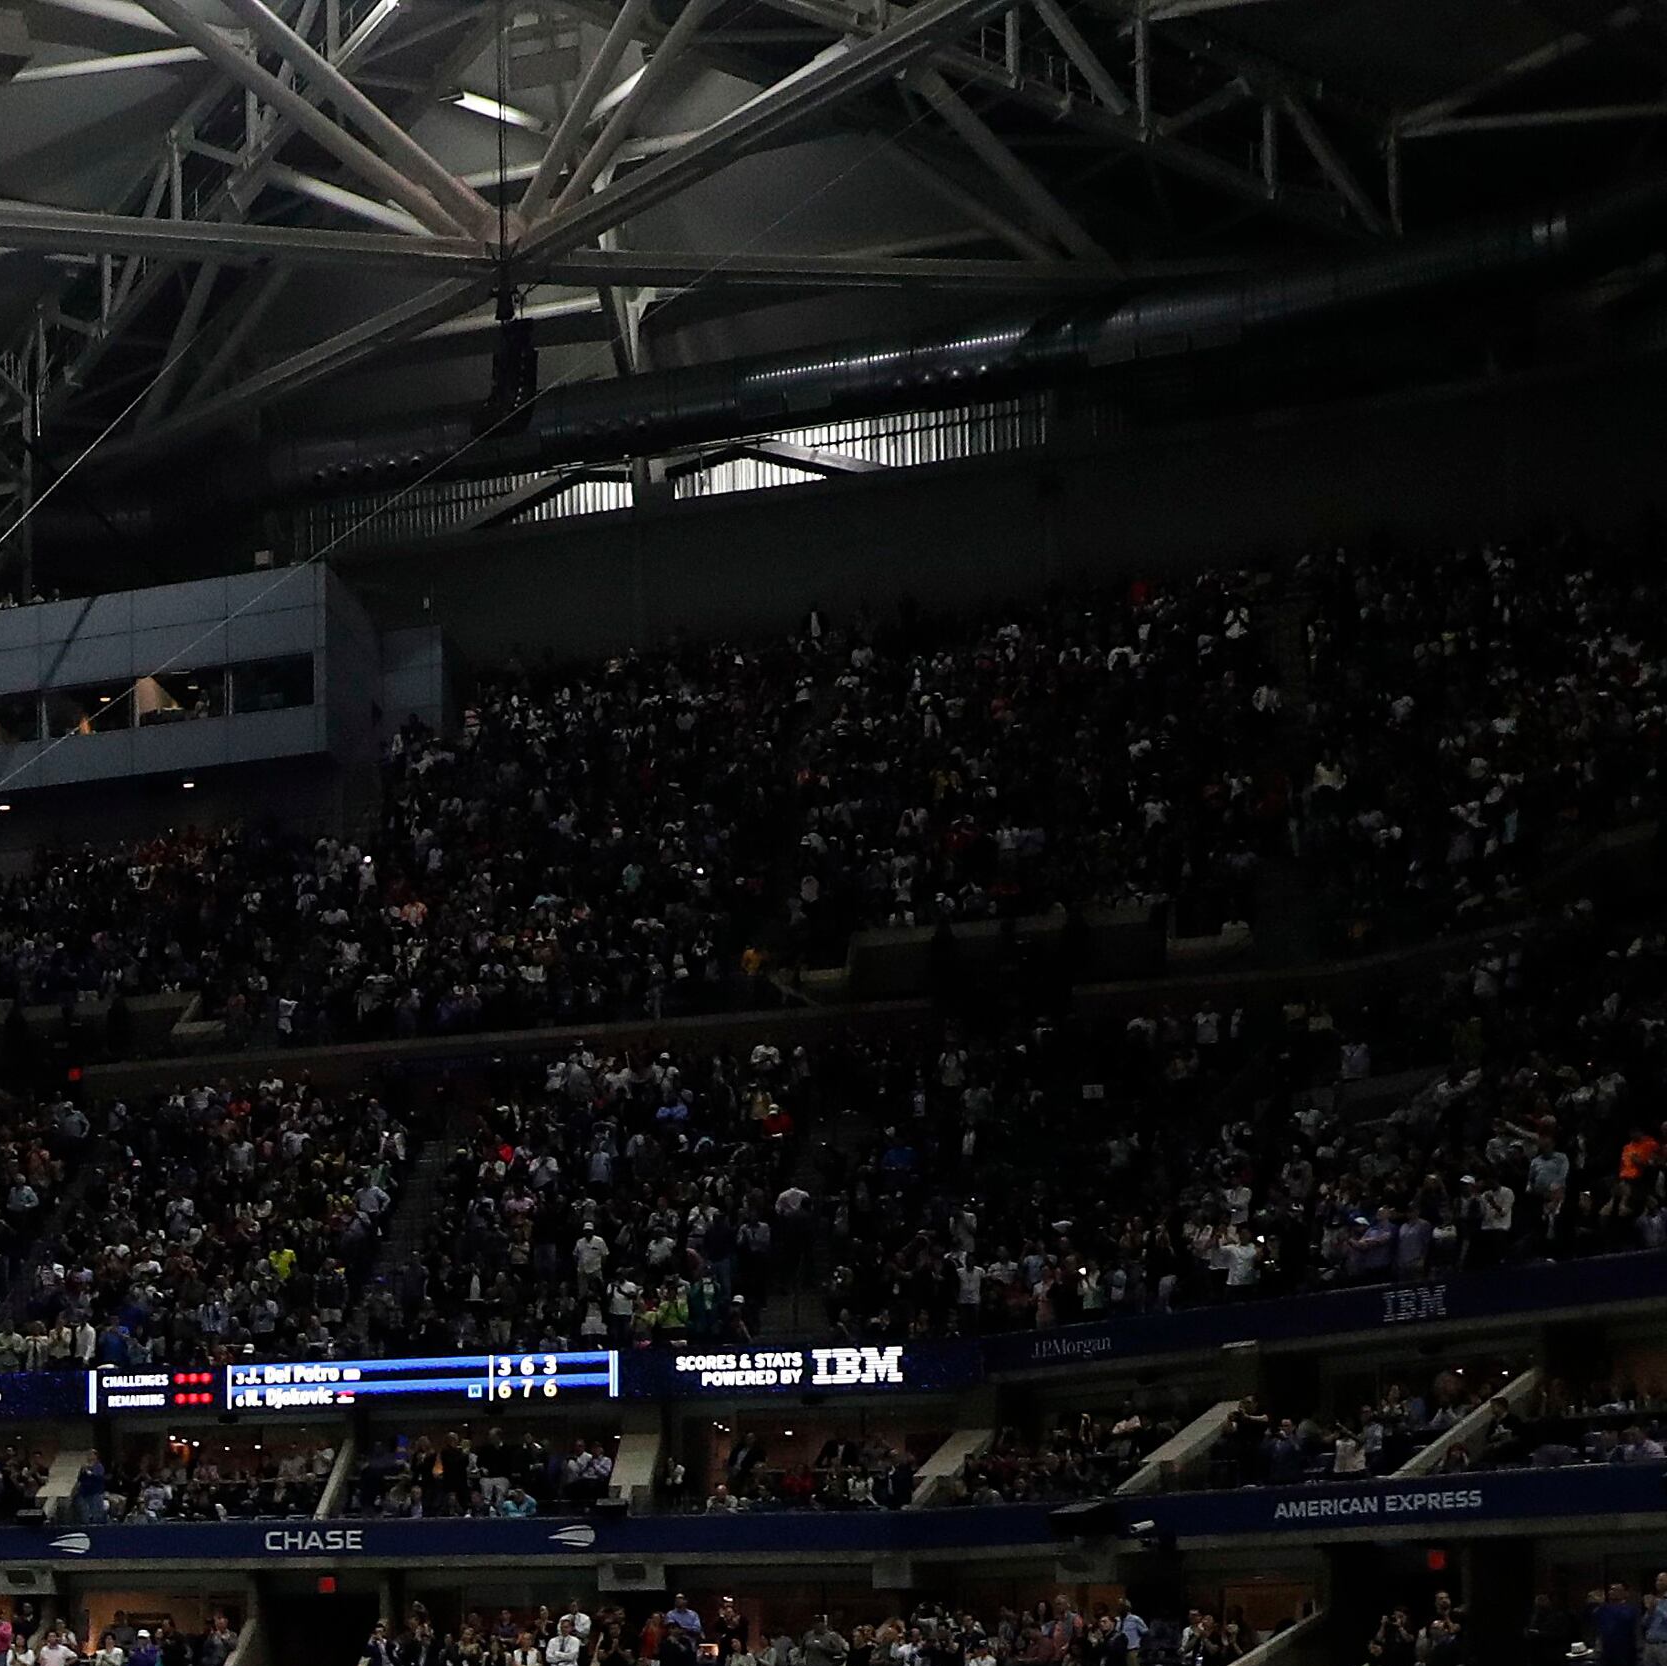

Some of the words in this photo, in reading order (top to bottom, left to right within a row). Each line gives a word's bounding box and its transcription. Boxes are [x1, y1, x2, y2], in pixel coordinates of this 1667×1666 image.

[1382, 1283, 1447, 1323] IBM
[1031, 1336, 1112, 1358] J.P.Morgan
[244, 1368, 262, 1385] J.
[264, 1365, 292, 1384] Del
[293, 1364, 340, 1383] Potro
[498, 1357, 512, 1376] 3
[520, 1356, 535, 1376] 6
[543, 1355, 557, 1375] 3
[676, 1355, 736, 1371] SCORES
[739, 1353, 752, 1369] &
[754, 1352, 803, 1369] STATS
[812, 1346, 903, 1385] IBM
[102, 1374, 169, 1388] CHALLENGES
[702, 1370, 777, 1387] POWERED
[780, 1369, 803, 1385] BY
[108, 1393, 165, 1408] REMAINING
[266, 1386, 333, 1409] Djokovic
[498, 1380, 512, 1399] 6
[521, 1379, 534, 1398] 7
[543, 1379, 557, 1398] 6
[1274, 1496, 1379, 1520] AMERICAN
[1384, 1489, 1483, 1513] EXPRESS
[264, 1530, 363, 1551] CHASE
